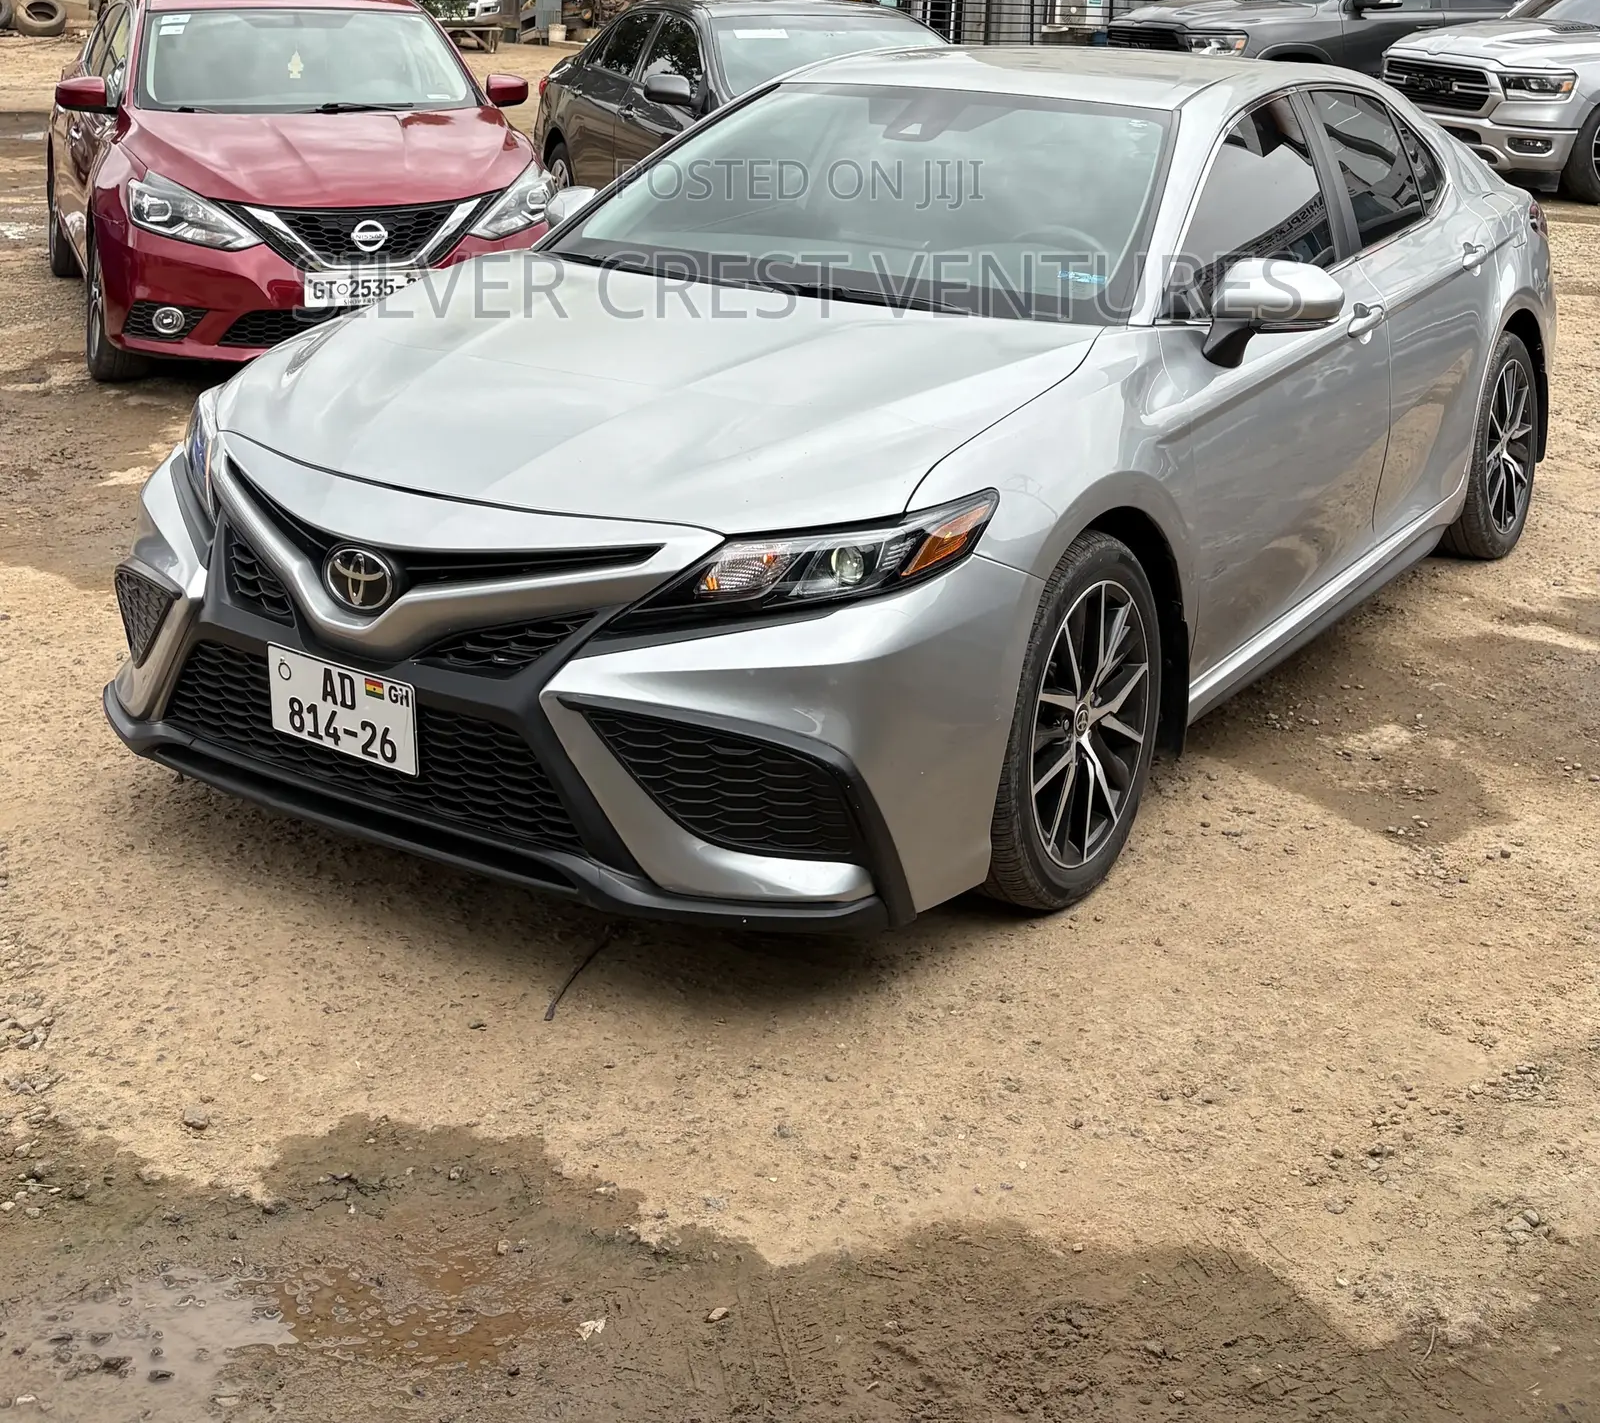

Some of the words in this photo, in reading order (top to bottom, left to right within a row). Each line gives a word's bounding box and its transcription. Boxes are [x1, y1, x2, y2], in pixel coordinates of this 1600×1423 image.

[312, 280, 337, 299] GT
[349, 277, 421, 298] 2535-
[322, 667, 356, 710] AD
[388, 685, 410, 708] GH
[288, 696, 397, 764] 814-26
